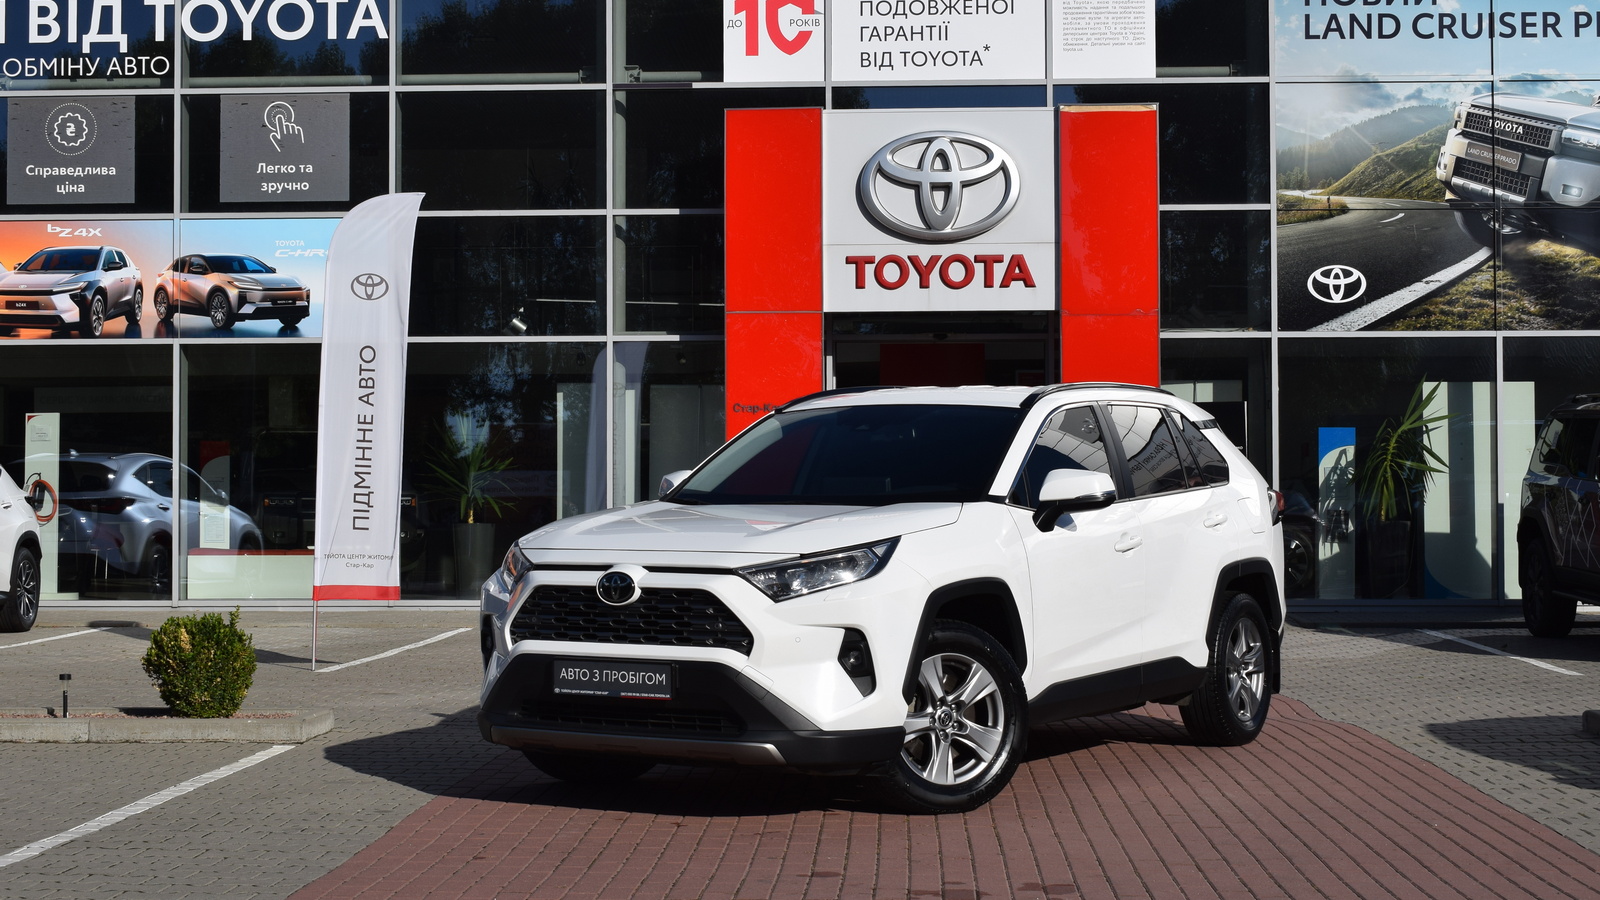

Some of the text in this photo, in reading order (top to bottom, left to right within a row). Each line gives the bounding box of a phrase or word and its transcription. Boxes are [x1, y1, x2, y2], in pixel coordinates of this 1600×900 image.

[28, 0, 128, 53] ВІД
[143, 0, 389, 42] TOYOTA
[727, 20, 743, 29] ДО
[789, 18, 821, 27] РОКІВ
[860, 21, 950, 42] ГАРАНТІЇ
[1304, 12, 1600, 39] LAND CRUISER P
[3, 56, 170, 77] ОБМІНУ АВТО
[860, 51, 894, 71] ВІД
[26, 164, 116, 178] Справедлива
[256, 162, 313, 174] Легко та
[56, 182, 85, 194] ціна
[260, 182, 310, 194] зручно
[845, 254, 1036, 290] TOYOTA
[733, 403, 780, 414] Стар-Ка
[352, 345, 376, 531] ПІДМІННЕ АВТО
[560, 668, 666, 686] АВТО З ПРОБІГОМ
